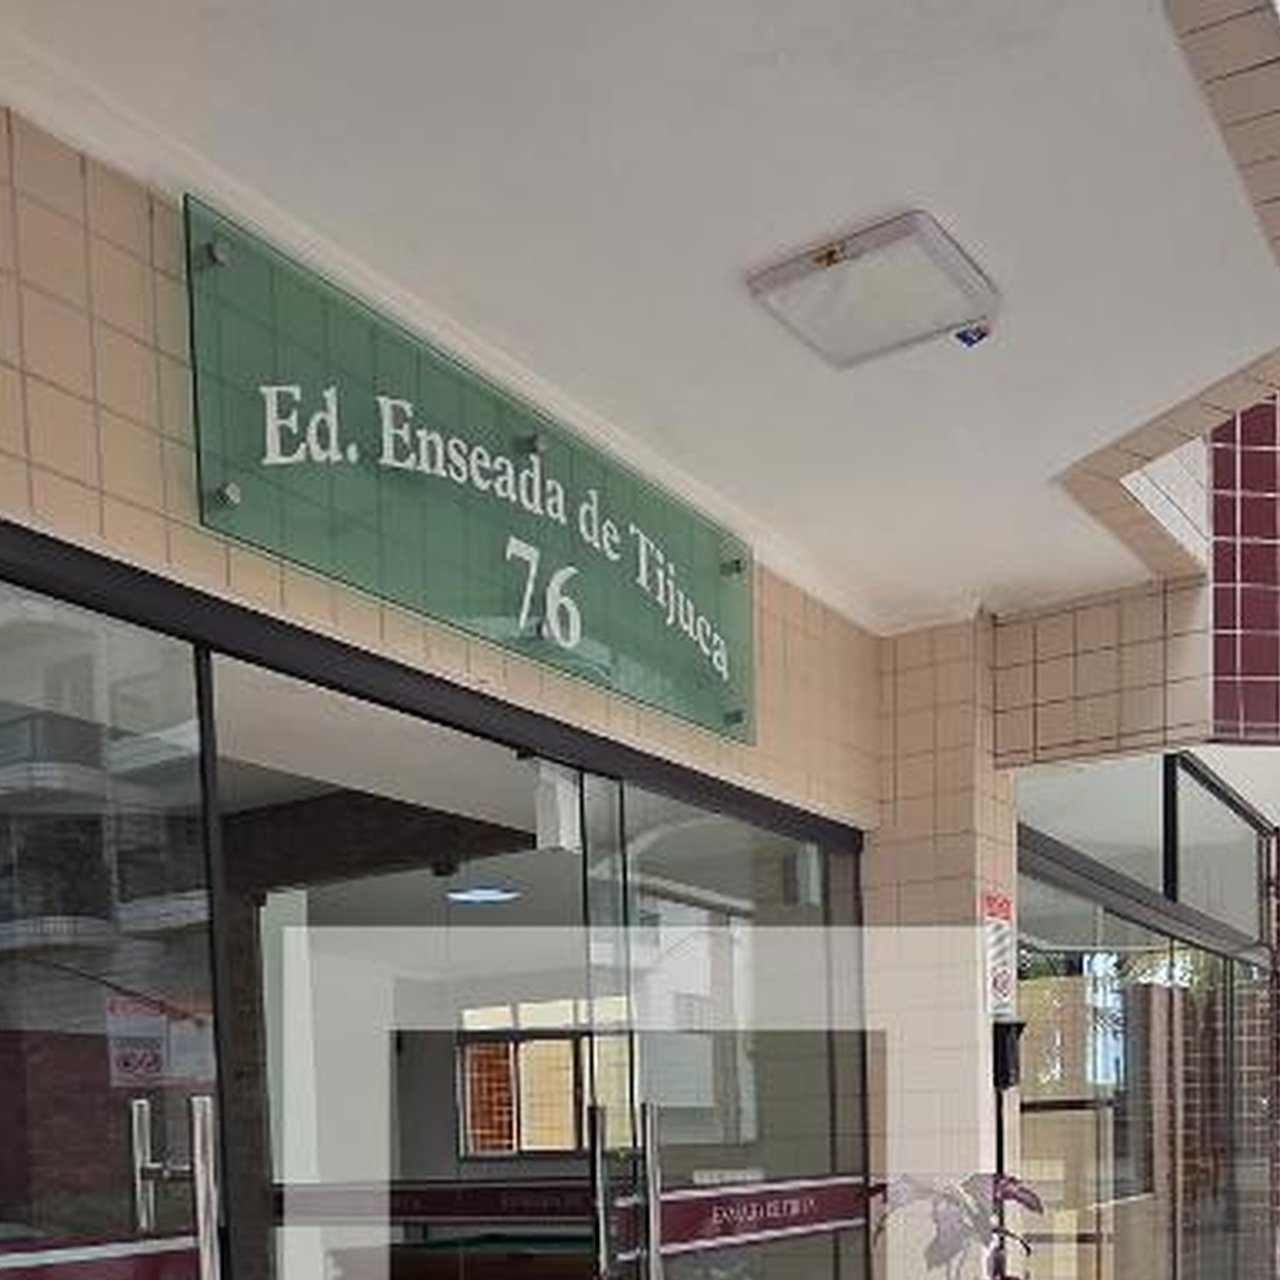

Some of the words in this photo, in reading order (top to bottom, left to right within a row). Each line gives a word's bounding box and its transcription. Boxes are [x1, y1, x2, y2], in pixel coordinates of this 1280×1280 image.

[258, 384, 360, 466] Ed.
[376, 395, 567, 525] Enseada
[578, 490, 620, 561] de
[628, 521, 730, 681] Tijuca
[505, 536, 584, 650] 76
